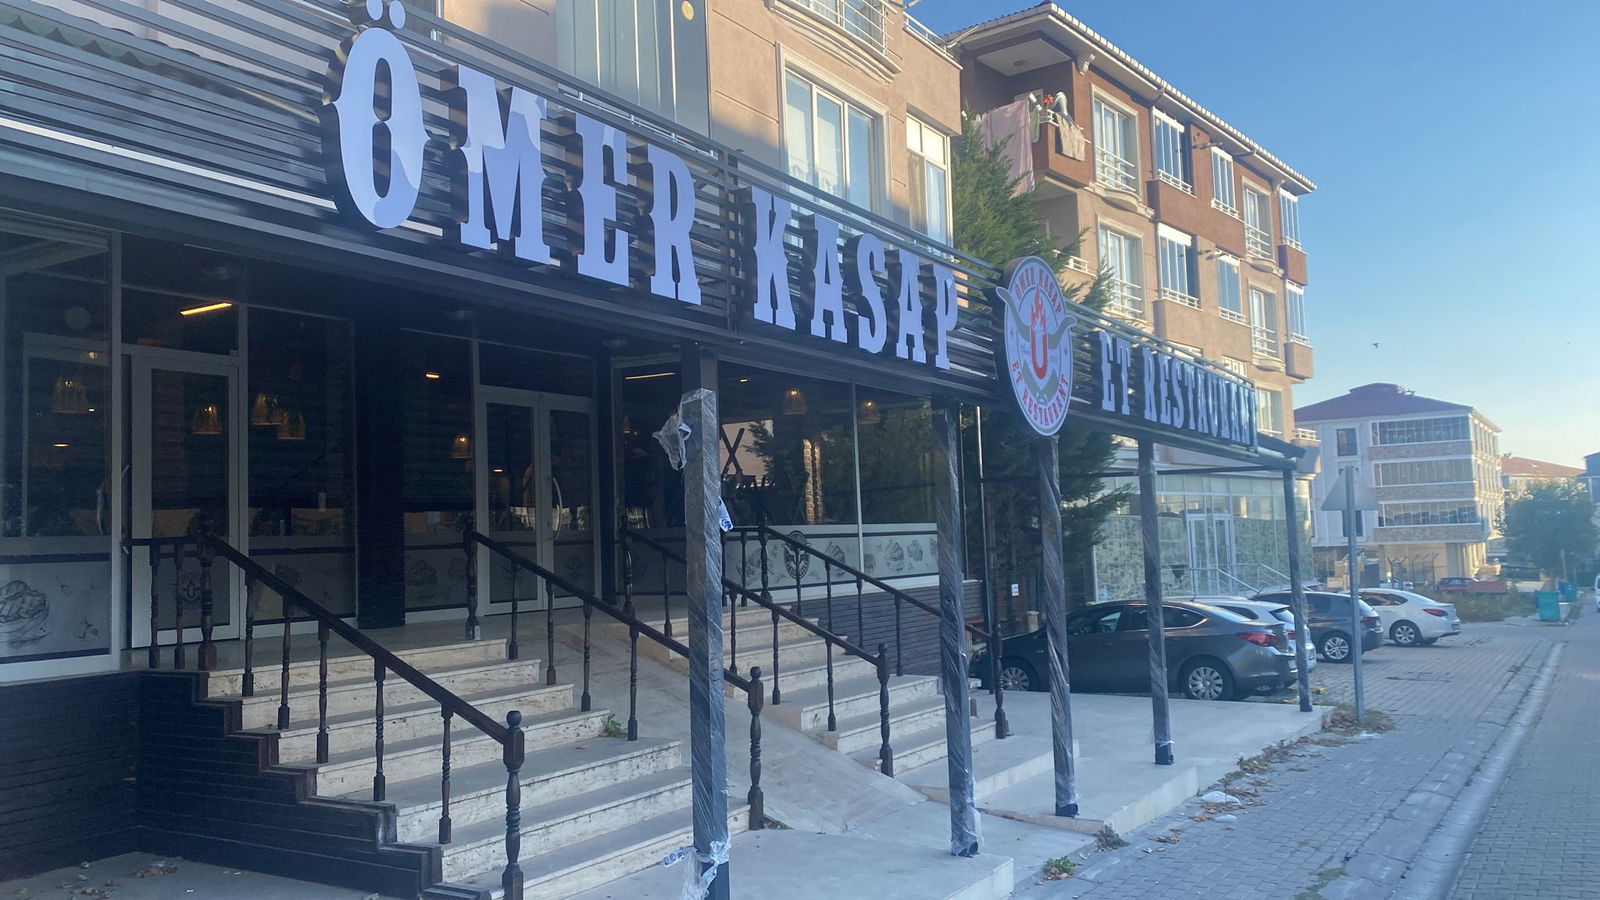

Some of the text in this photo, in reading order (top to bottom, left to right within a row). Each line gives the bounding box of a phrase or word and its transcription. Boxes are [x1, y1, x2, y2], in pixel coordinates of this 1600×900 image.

[331, 0, 958, 370] ÖMER KASAP
[1038, 267, 1062, 313] KASAP
[1011, 360, 1069, 426] ET RESTAURANT
[1099, 329, 1131, 416] ET
